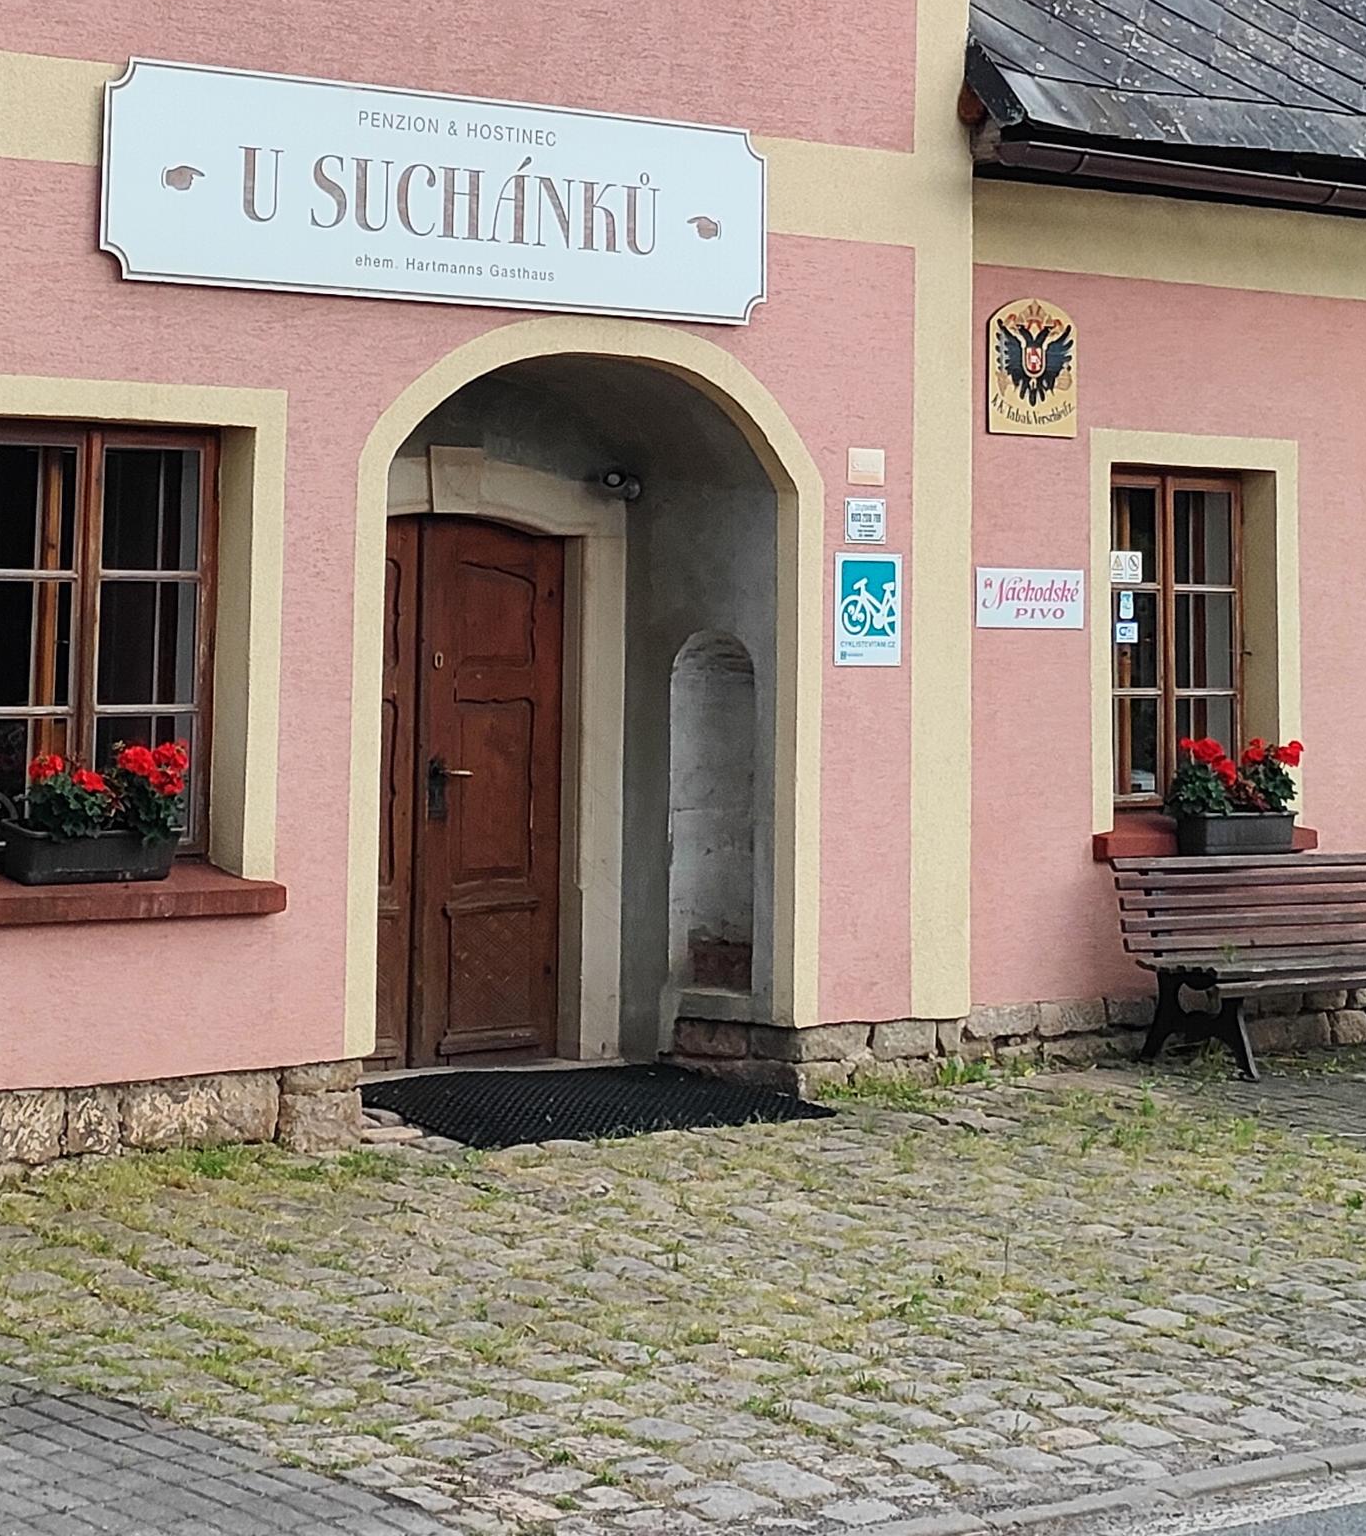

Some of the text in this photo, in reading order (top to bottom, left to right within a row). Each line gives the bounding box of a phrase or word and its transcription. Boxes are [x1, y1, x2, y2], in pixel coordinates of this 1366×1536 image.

[358, 110, 557, 147] PENZION & HOSTINEC
[238, 145, 661, 256] U SUCHÁNKŮ
[355, 253, 555, 282] ehem. Hartmanns Gasthaus
[1006, 405, 1032, 425] Tabak
[1014, 607, 1065, 620] PIVO
